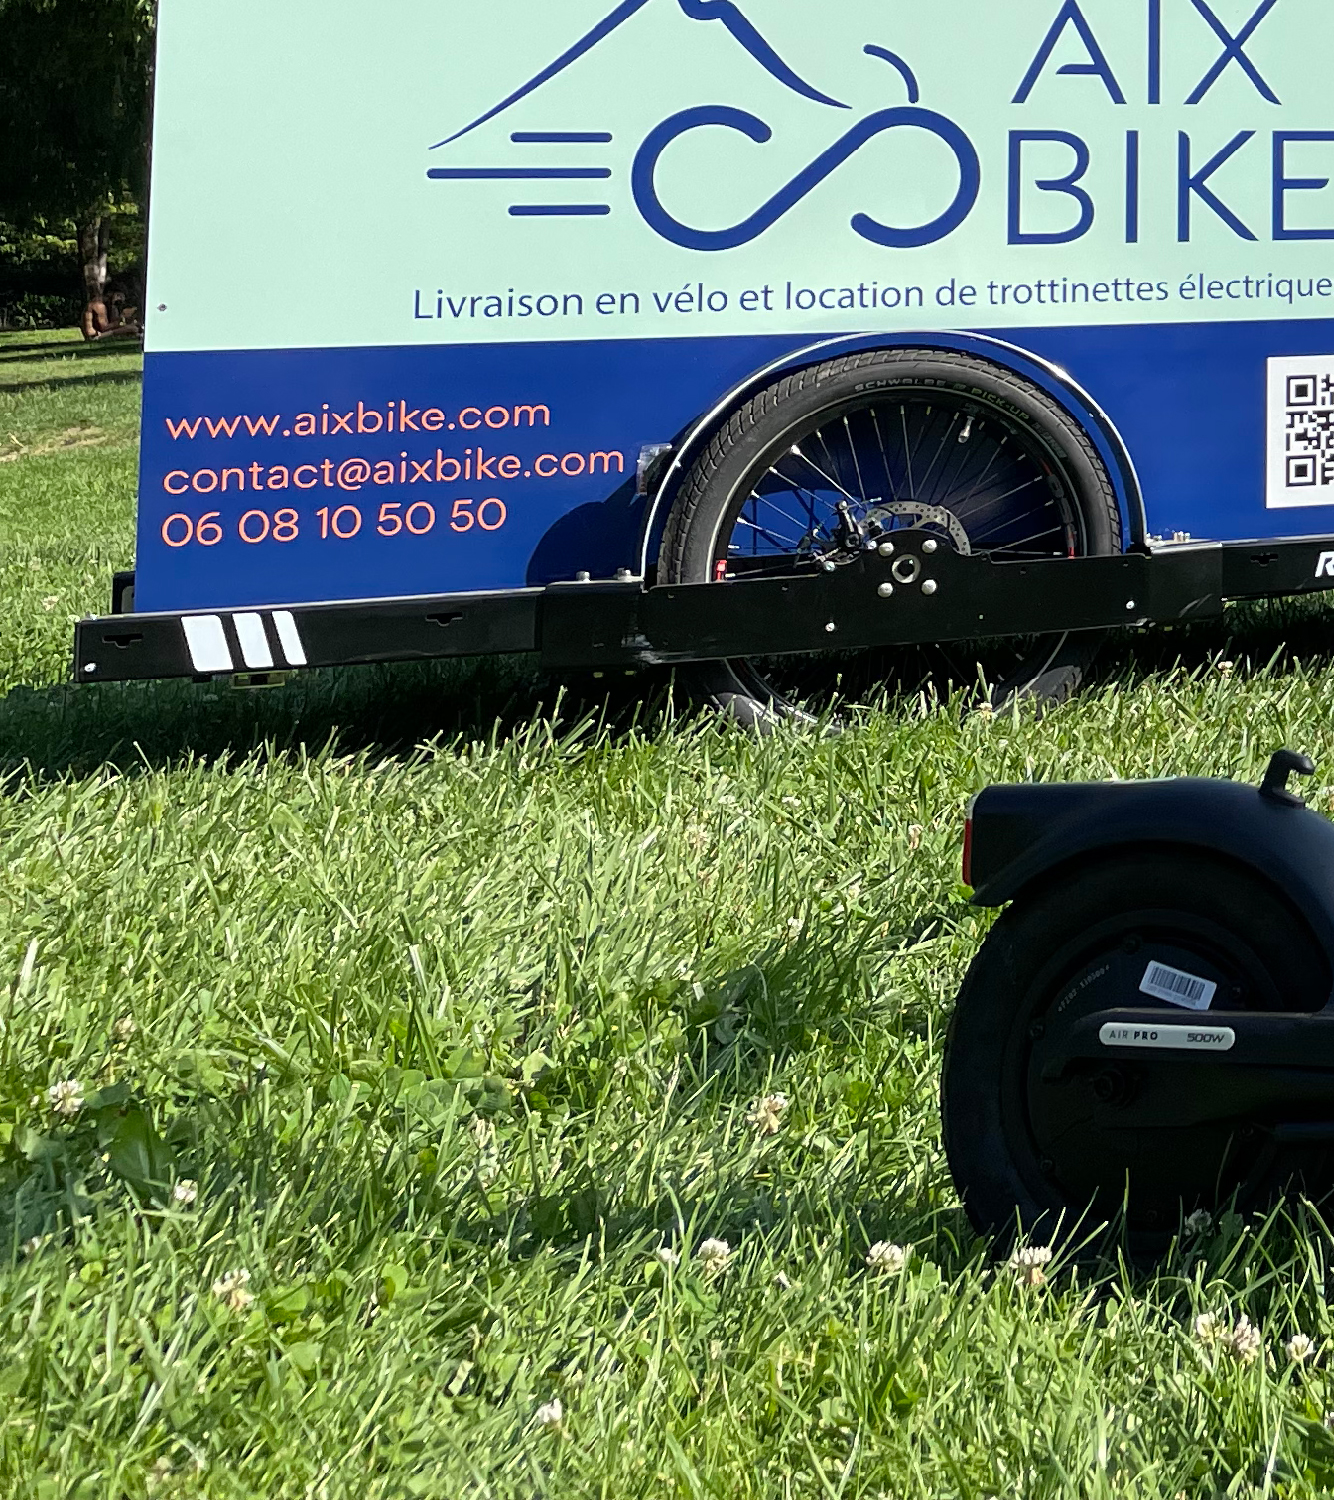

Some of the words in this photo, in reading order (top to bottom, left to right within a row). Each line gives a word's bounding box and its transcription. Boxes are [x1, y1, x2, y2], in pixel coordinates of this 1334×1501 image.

[414, 288, 583, 320] Livraison
[596, 292, 640, 315] en
[653, 283, 728, 313] vélo
[740, 285, 774, 311] et
[787, 281, 923, 310] location
[935, 278, 977, 307] de
[987, 277, 1169, 305] trottinettes
[854, 378, 947, 393] SCHWALBE
[165, 400, 551, 440] www.aixbike.com
[163, 447, 625, 495] contact@aixbike.com
[161, 511, 223, 547] 06
[238, 508, 299, 543] 08
[317, 505, 362, 539] 10
[376, 501, 436, 536] 50
[450, 497, 507, 532] 50
[1109, 1030, 1128, 1039] AIR
[1133, 1030, 1158, 1041] PRO
[1186, 1032, 1225, 1043] 500W
